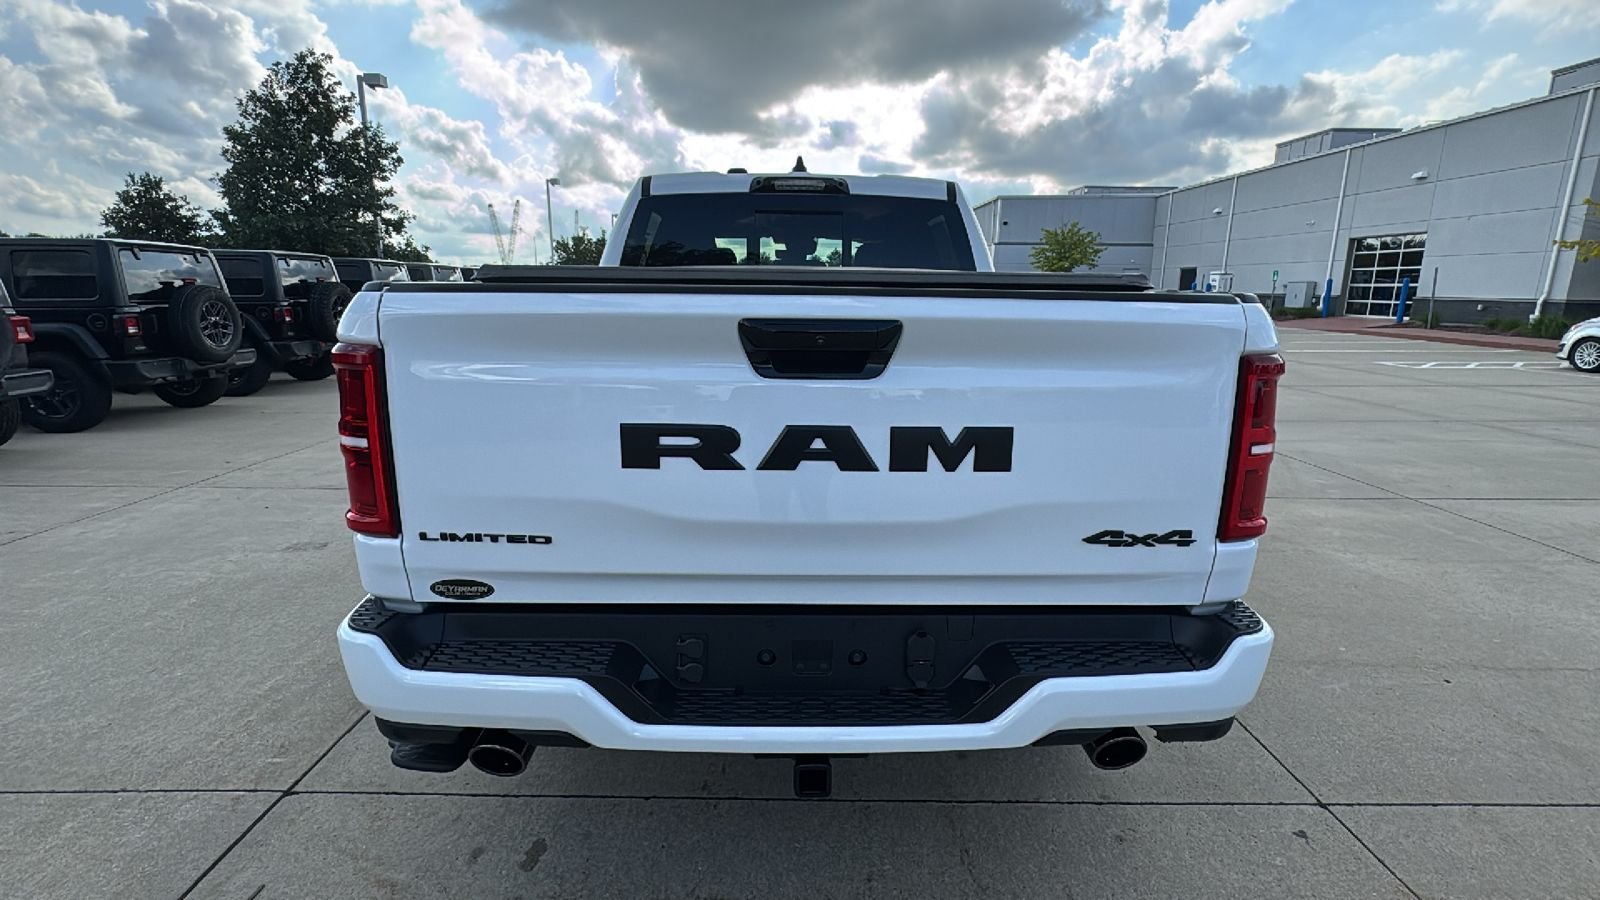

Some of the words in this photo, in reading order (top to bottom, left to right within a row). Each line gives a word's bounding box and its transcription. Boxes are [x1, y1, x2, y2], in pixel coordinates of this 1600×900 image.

[620, 423, 1015, 473] RAM
[419, 532, 552, 544] LIMITED
[1082, 530, 1197, 547] 4x4
